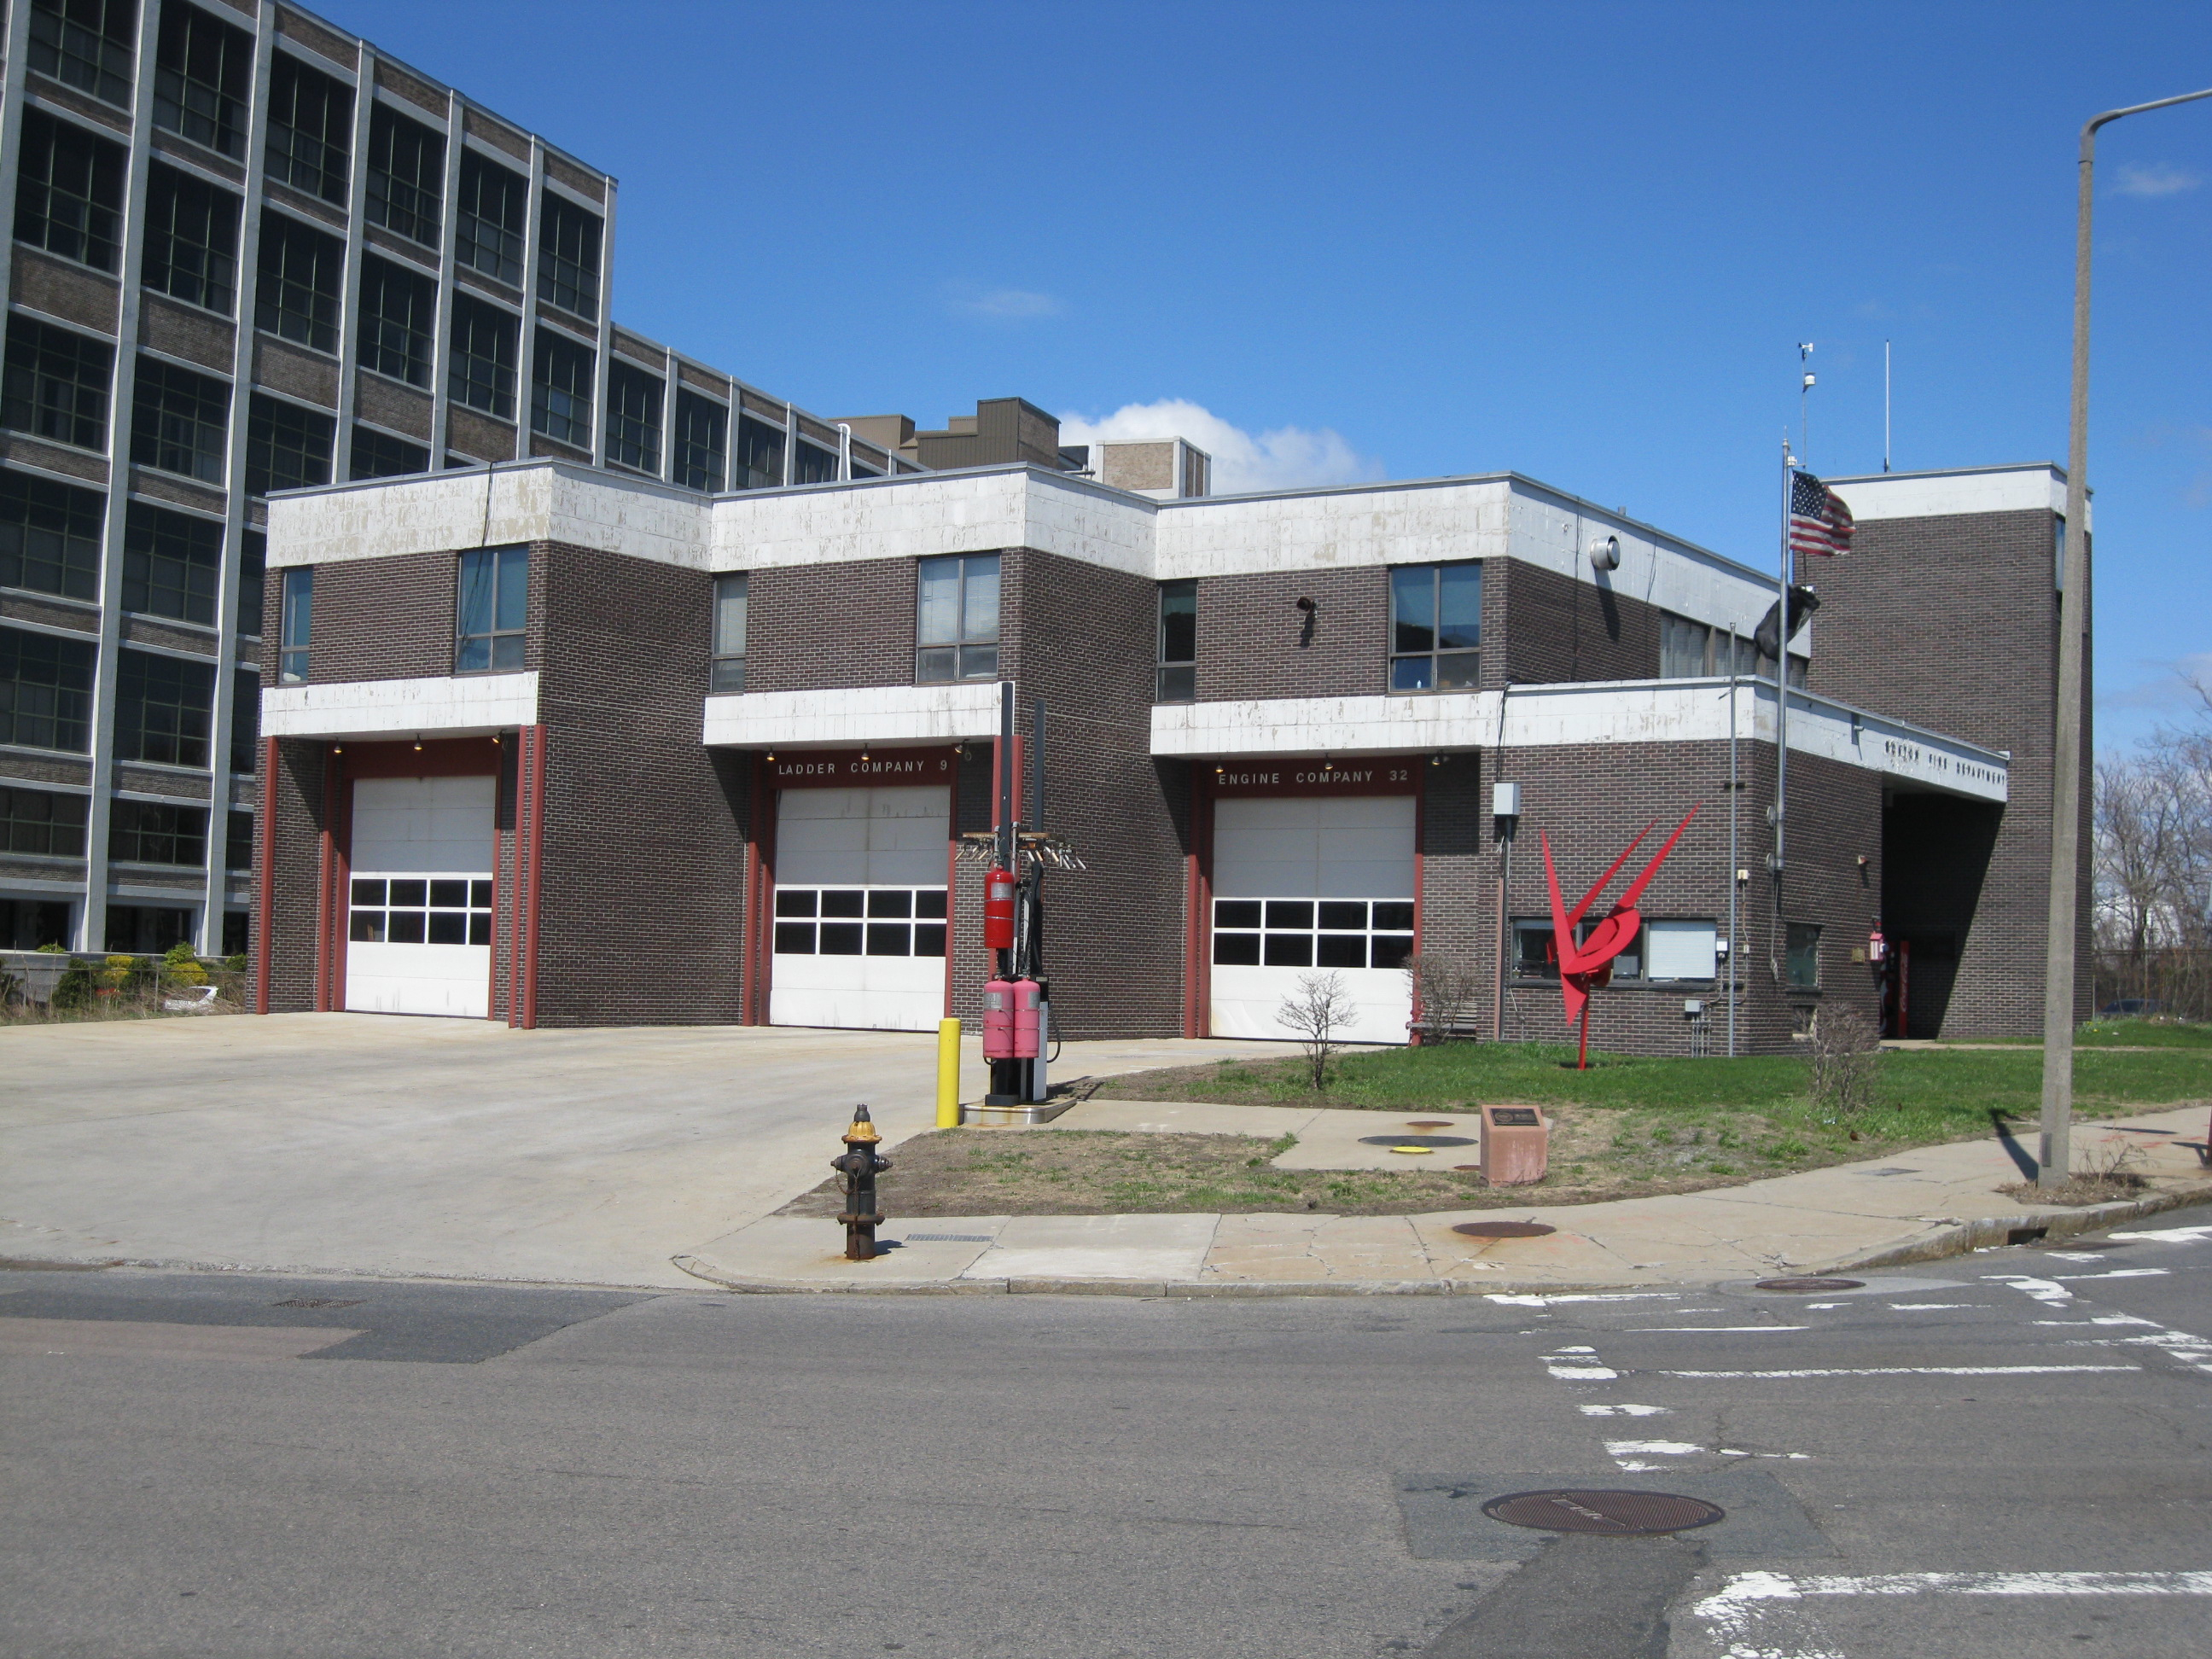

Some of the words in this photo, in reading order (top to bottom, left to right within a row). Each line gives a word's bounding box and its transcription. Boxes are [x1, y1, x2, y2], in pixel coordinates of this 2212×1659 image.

[778, 763, 835, 775] LADDER
[850, 760, 924, 774] COMPANY
[940, 760, 947, 771] 9
[1929, 754, 1947, 770] FIRE
[1956, 761, 2005, 785] DEPARTMENT
[1219, 772, 1280, 785] ENGINE
[1295, 770, 1373, 783] COMPANY
[1389, 769, 1408, 781] 32
